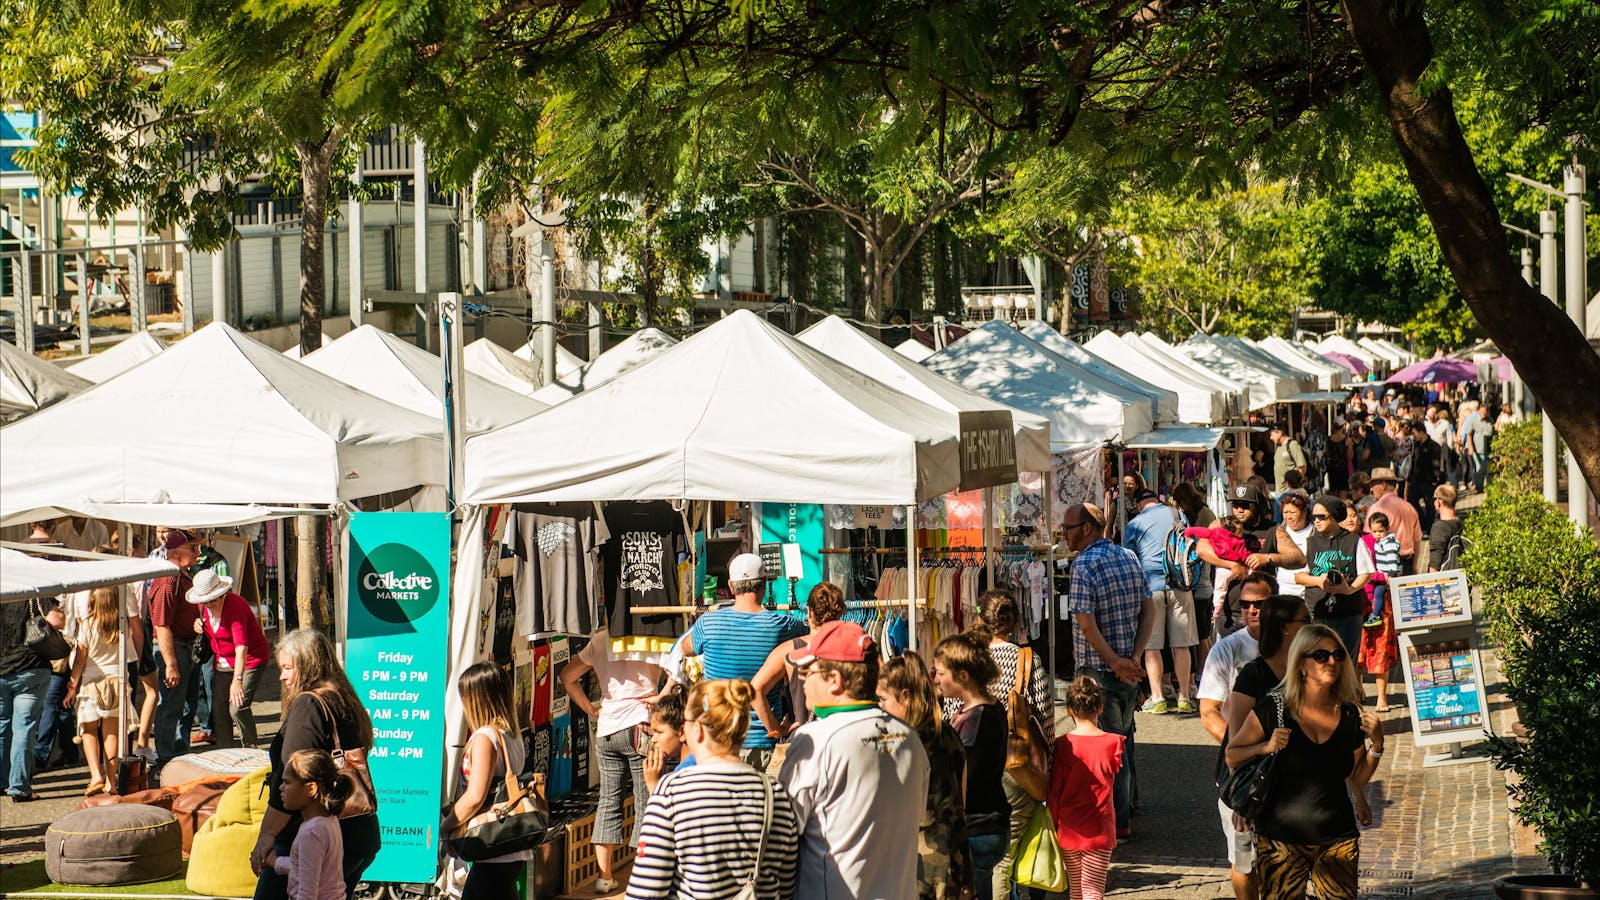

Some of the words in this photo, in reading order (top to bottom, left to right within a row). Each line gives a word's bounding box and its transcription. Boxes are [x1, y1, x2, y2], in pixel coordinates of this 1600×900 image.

[962, 431, 978, 472] THE
[861, 505, 885, 514] LADIES
[626, 531, 658, 546] SONS
[621, 550, 664, 565] ANARCHY
[363, 571, 432, 591] Collective
[376, 592, 419, 600] MARKETS
[378, 652, 413, 665] Friday
[362, 670, 369, 681] 5
[372, 671, 390, 681] PM
[400, 671, 407, 682] 9
[410, 672, 428, 682] PM
[369, 690, 419, 703] Saturday
[1436, 692, 1458, 704] Live
[373, 709, 392, 719] AM
[402, 709, 409, 720] 9
[412, 710, 430, 720] PM
[1434, 703, 1464, 715] Music
[373, 728, 414, 741] Sunday
[370, 747, 388, 757] AM
[398, 748, 423, 758] 4PM
[402, 788, 428, 796] Markets
[396, 826, 423, 836] BANK
